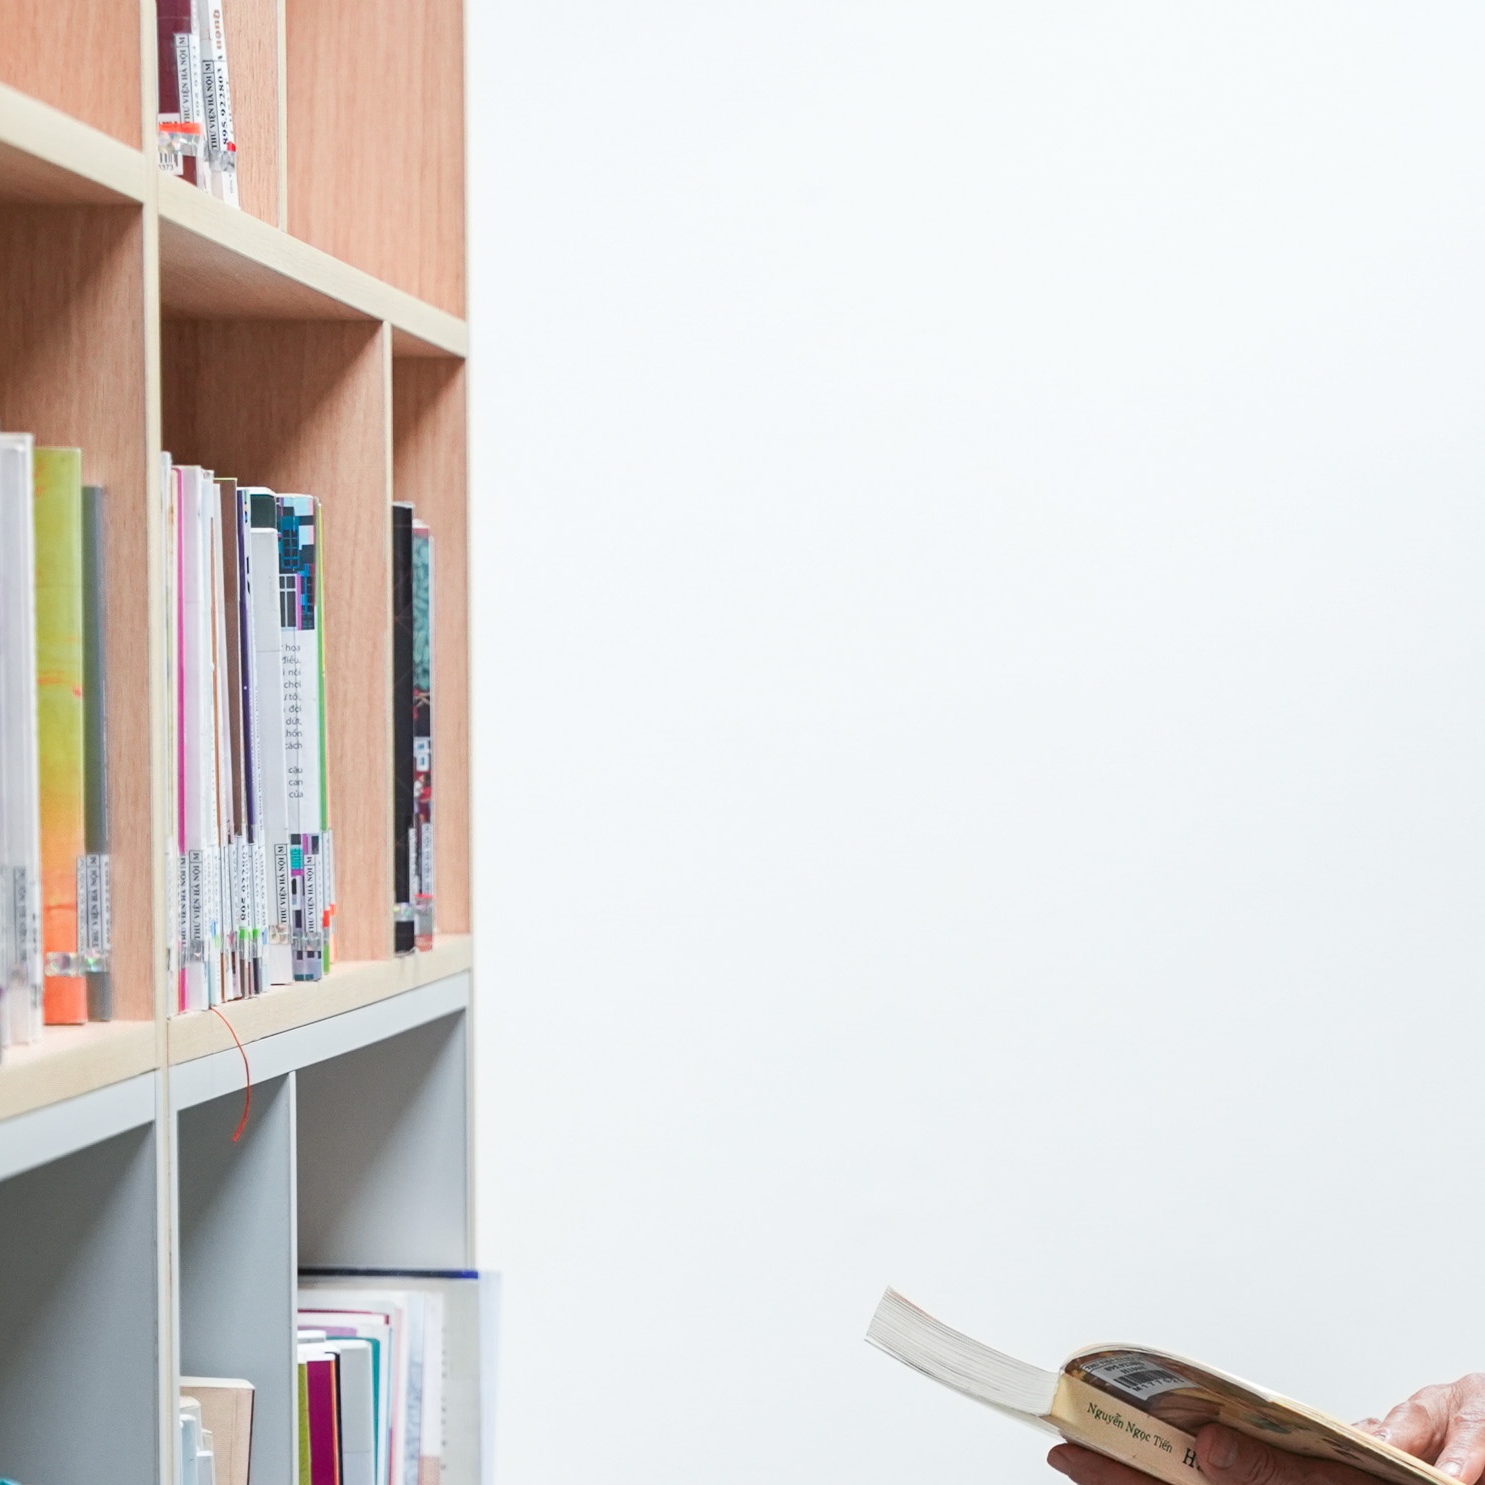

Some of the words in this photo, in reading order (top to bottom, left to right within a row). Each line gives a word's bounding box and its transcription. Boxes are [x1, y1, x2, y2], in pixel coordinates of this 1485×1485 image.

[179, 37, 185, 45] M
[179, 50, 187, 66] NỘI
[180, 68, 188, 80] HÀ
[205, 63, 211, 71] M
[206, 75, 214, 92] NỘI
[181, 83, 189, 104] VIỆN
[206, 94, 214, 106] HÀ
[208, 109, 216, 128] VIỆN
[193, 852, 199, 860] M
[278, 857, 286, 871] NỘI
[192, 865, 201, 881] NỘI
[277, 874, 285, 885] HÀ
[305, 867, 314, 881] NỘI
[191, 884, 200, 896] HÀ
[279, 887, 287, 905] VIỆN
[305, 884, 313, 895] HÀ
[193, 898, 201, 919] VIỆN
[306, 897, 315, 916] VIỆN
[1087, 1402, 1124, 1429] Nguyễn
[1125, 1421, 1151, 1443] Ngọc
[1153, 1434, 1173, 1453] Tiến
[1182, 1447, 1204, 1472] H
